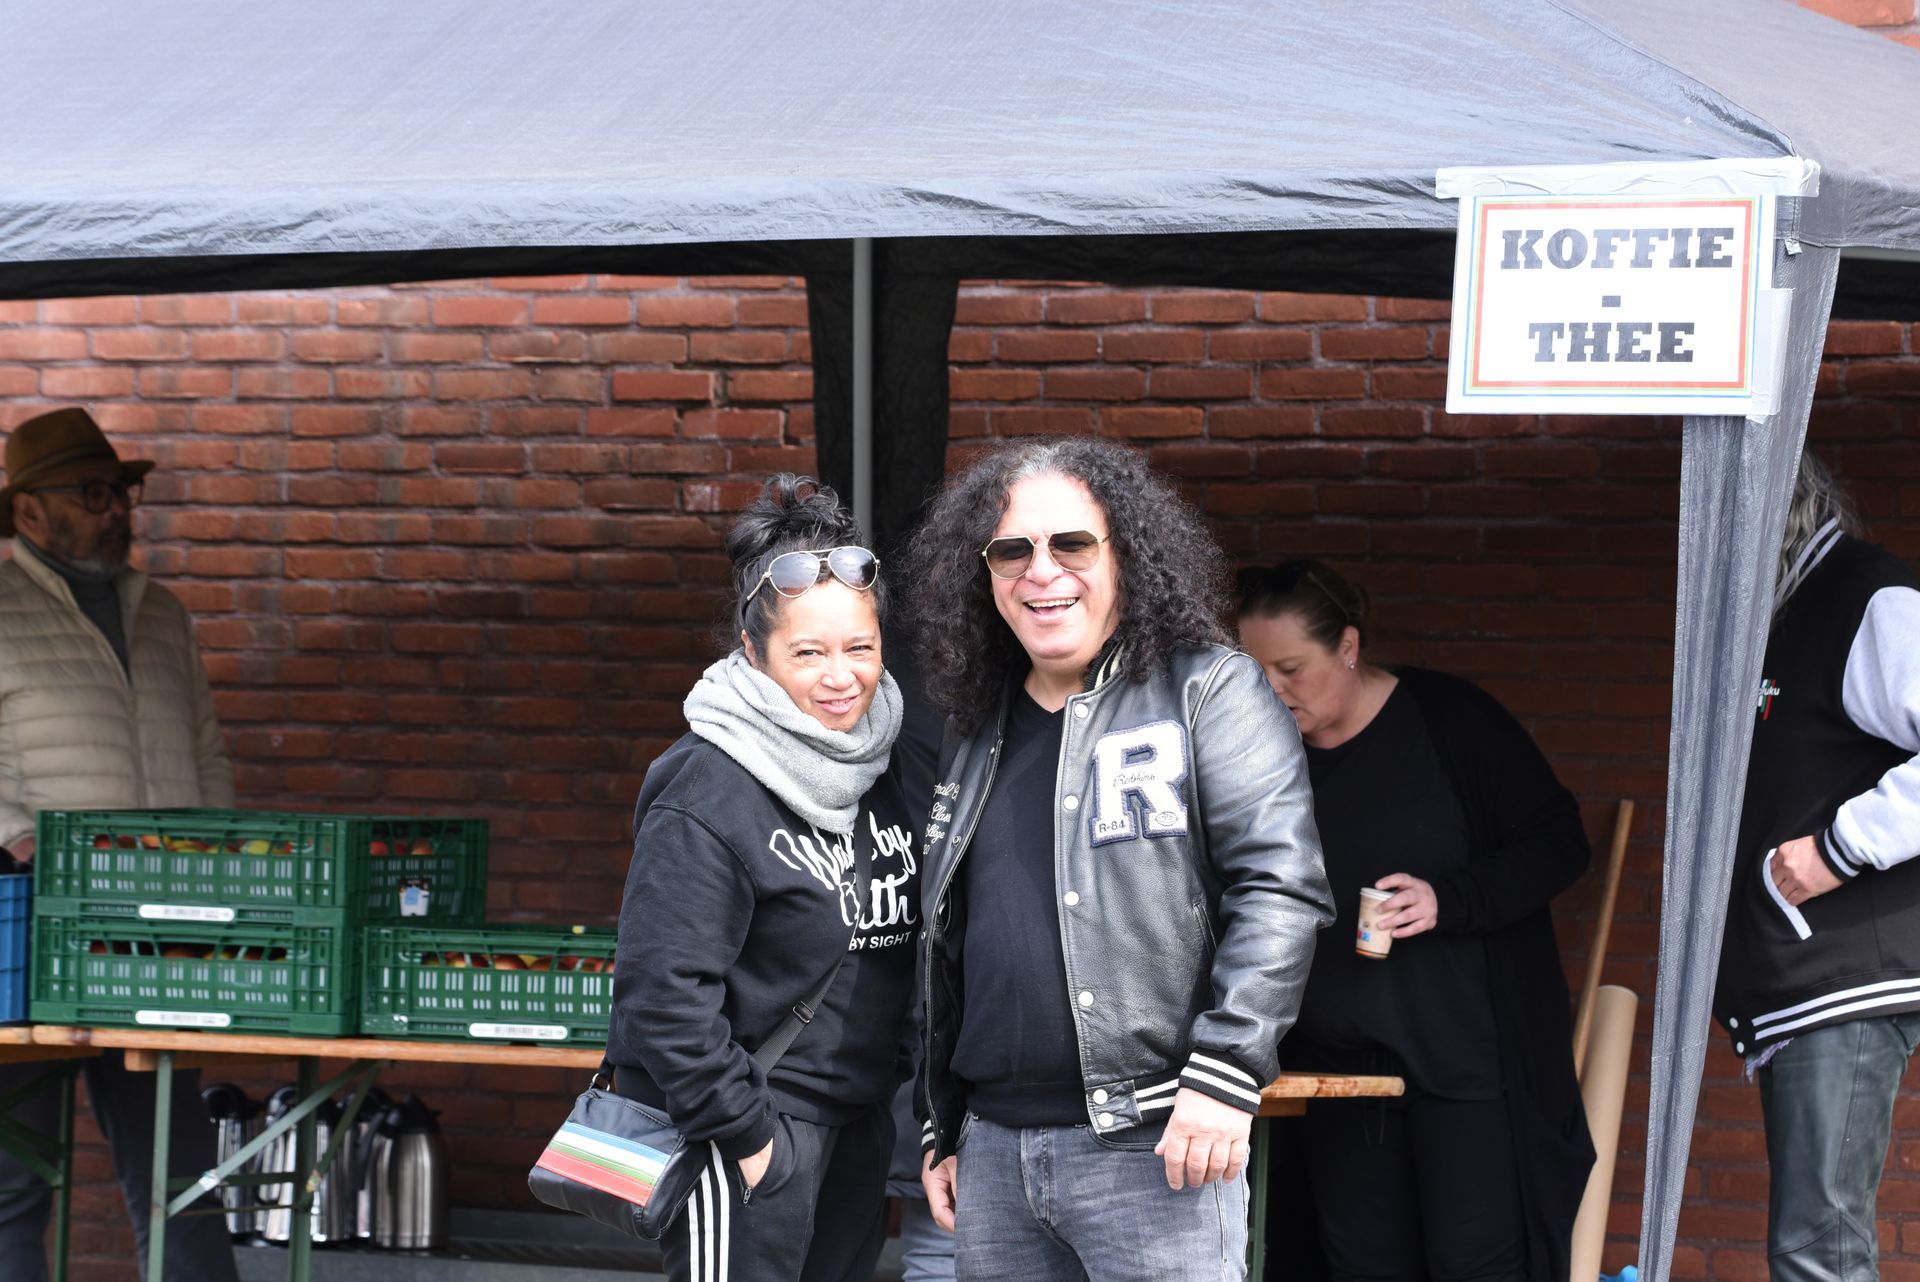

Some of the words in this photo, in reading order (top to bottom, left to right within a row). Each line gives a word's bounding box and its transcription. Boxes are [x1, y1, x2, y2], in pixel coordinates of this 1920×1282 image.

[1500, 227, 1735, 270] KOFFIE
[1528, 322, 1695, 363] THEE
[1090, 720, 1189, 848] R
[869, 811, 917, 875] by
[1098, 820, 1126, 834] R-84
[848, 936, 867, 951] BY
[869, 931, 914, 950] SIGHT
